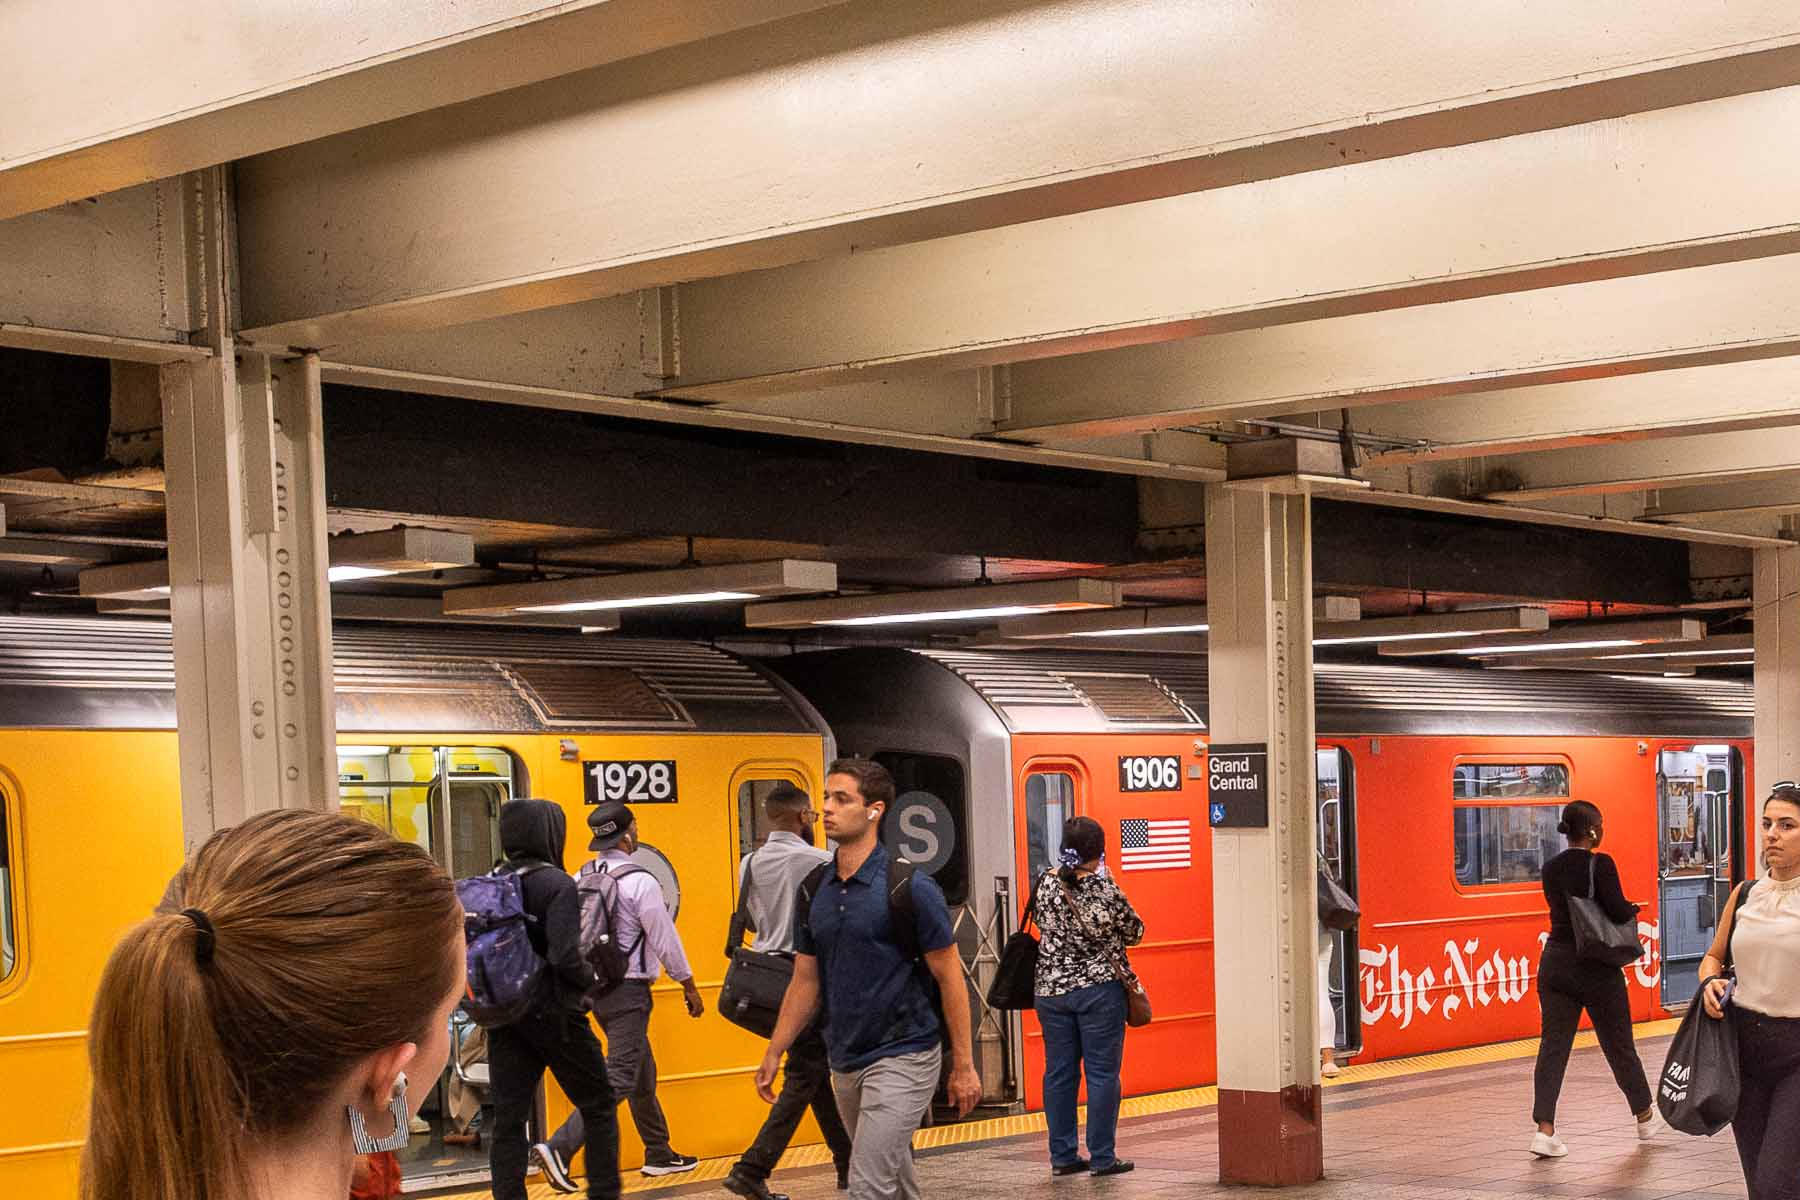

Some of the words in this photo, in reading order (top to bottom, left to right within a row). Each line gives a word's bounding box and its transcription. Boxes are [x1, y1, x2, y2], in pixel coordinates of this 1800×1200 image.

[590, 763, 671, 801] 1928
[1122, 757, 1178, 789] 1906
[1209, 757, 1249, 773] Grand
[1209, 774, 1258, 791] Central
[898, 804, 939, 863] S
[1360, 943, 1437, 1030] The
[1442, 937, 1530, 1020] New
